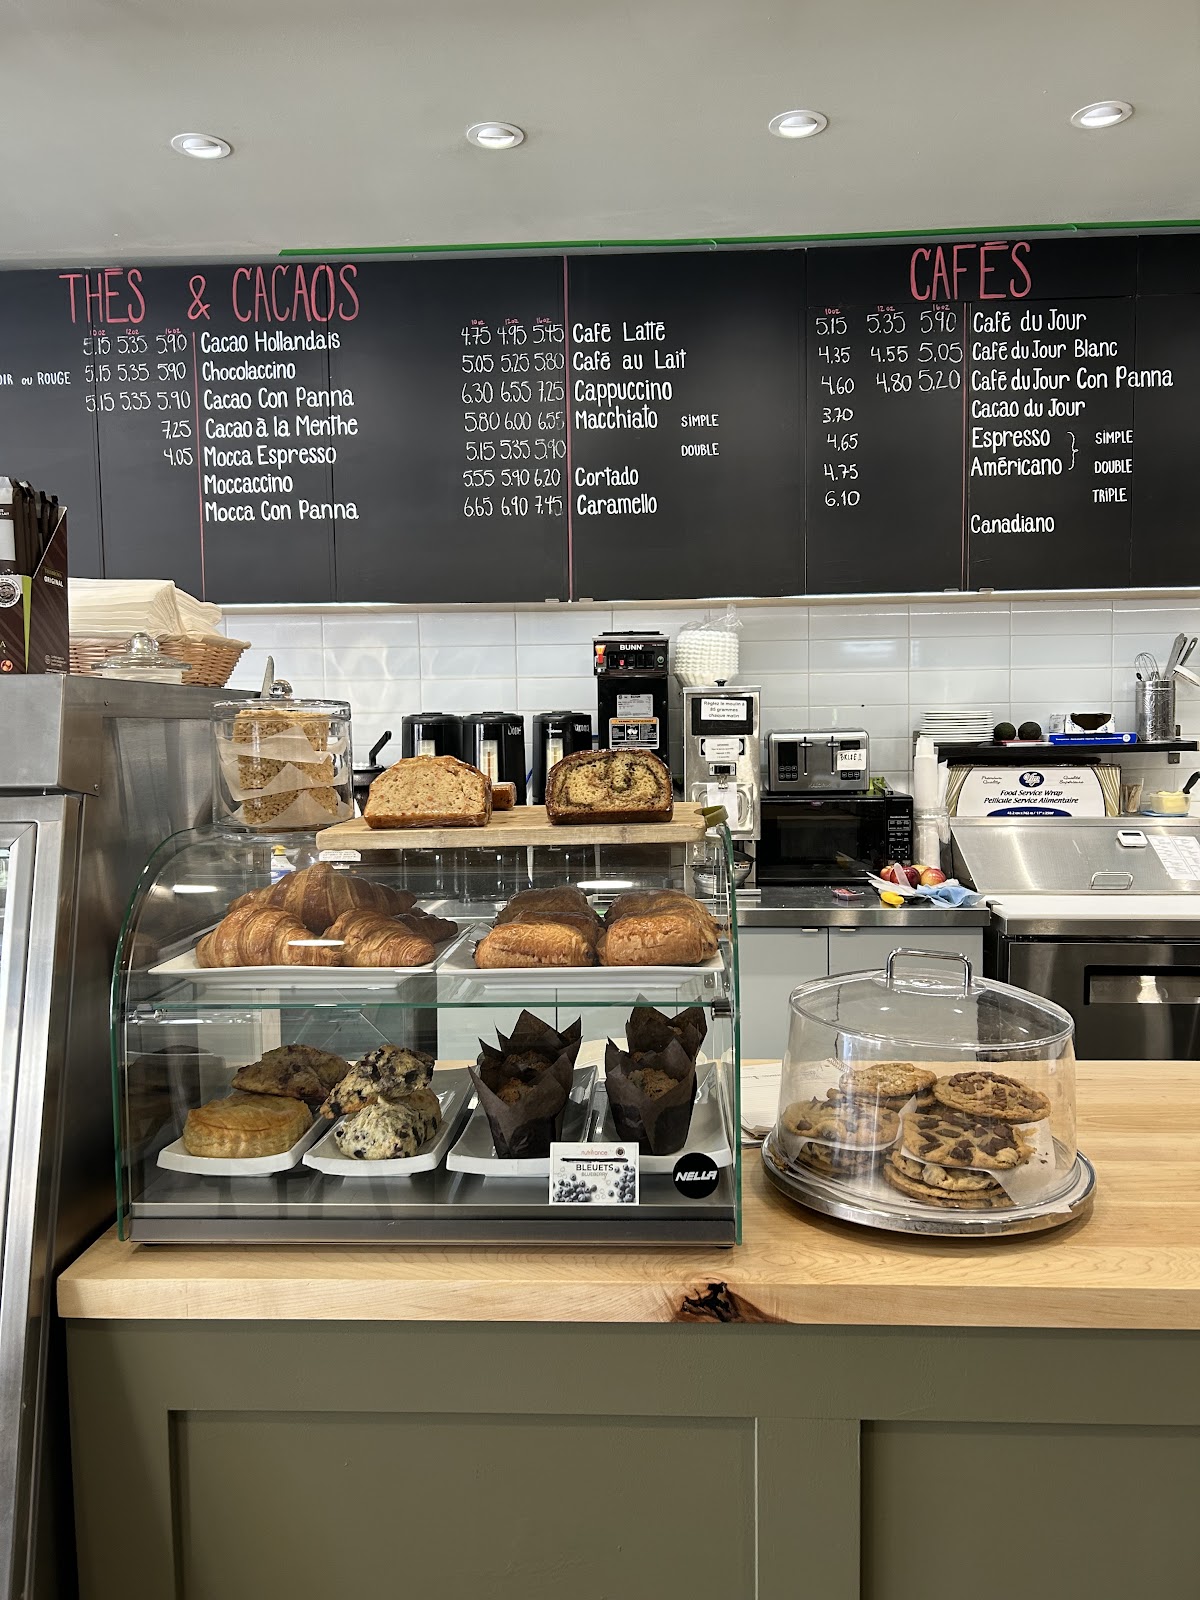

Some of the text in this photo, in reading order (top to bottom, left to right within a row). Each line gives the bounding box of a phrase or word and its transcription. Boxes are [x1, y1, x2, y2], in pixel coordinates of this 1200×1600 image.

[909, 240, 1032, 301] CAFÉS
[59, 264, 359, 323] THÉS & CACAOS
[866, 311, 906, 334] 5.35
[973, 308, 1087, 333] Café du Jour
[201, 330, 341, 353] Cacao Hollandais
[461, 326, 491, 346] 4.75
[497, 325, 527, 346] 4.95
[572, 321, 666, 343] Café Latté
[117, 335, 148, 354] 5.35
[818, 345, 851, 364] 4.35
[870, 345, 909, 363] 4.55
[972, 338, 1118, 361] Café du Jour Blanc
[202, 360, 296, 381] Chocolaccino
[462, 354, 494, 373] 5.05
[572, 348, 687, 371] Café au Lait
[21, 377, 33, 386] ou
[37, 371, 72, 385] ROUGE
[157, 362, 186, 381] 5.90
[971, 364, 1174, 391] Café du Jour Con Panna
[461, 381, 494, 404] 6.30
[500, 381, 532, 402] 6.55
[574, 379, 673, 408] Cappuccino
[821, 375, 855, 396] 4.60
[876, 372, 913, 394] 4.80
[85, 392, 115, 412] 5.15
[157, 390, 191, 410] 5.90
[203, 386, 354, 410] Cacao Con Panna
[971, 397, 1086, 419] Cacao du Jour
[205, 414, 359, 439] Cacao à la Menthe
[464, 412, 501, 432] 5.80
[504, 411, 532, 430] 6.00
[575, 404, 719, 430] Macchiato SIMPLE
[466, 441, 496, 461] 5.15
[500, 439, 531, 460] 5.35
[681, 442, 720, 457] DOUBLE
[972, 426, 1133, 454] Espresso SIMPLE
[163, 448, 193, 466] 4.05
[203, 445, 337, 470] Mocca Espresso
[970, 456, 1133, 477] Américano DOUBLE
[462, 468, 561, 488] 5.55 5.90 6.20
[575, 466, 639, 487] Cortado
[823, 463, 859, 482] 4.75
[204, 473, 293, 495] Moccaccino
[1092, 487, 1127, 503] TRIPLE
[463, 496, 494, 517] 6.65
[501, 495, 529, 516] 6.90
[577, 493, 658, 516] Caramello
[825, 490, 861, 507] 6.10
[204, 499, 359, 522] Mocca Con Panna
[970, 513, 1055, 535] Canadiano
[1044, 789, 1063, 798] Wrap
[576, 1163, 614, 1171] BLEUETS
[675, 1170, 718, 1182] NELLA
